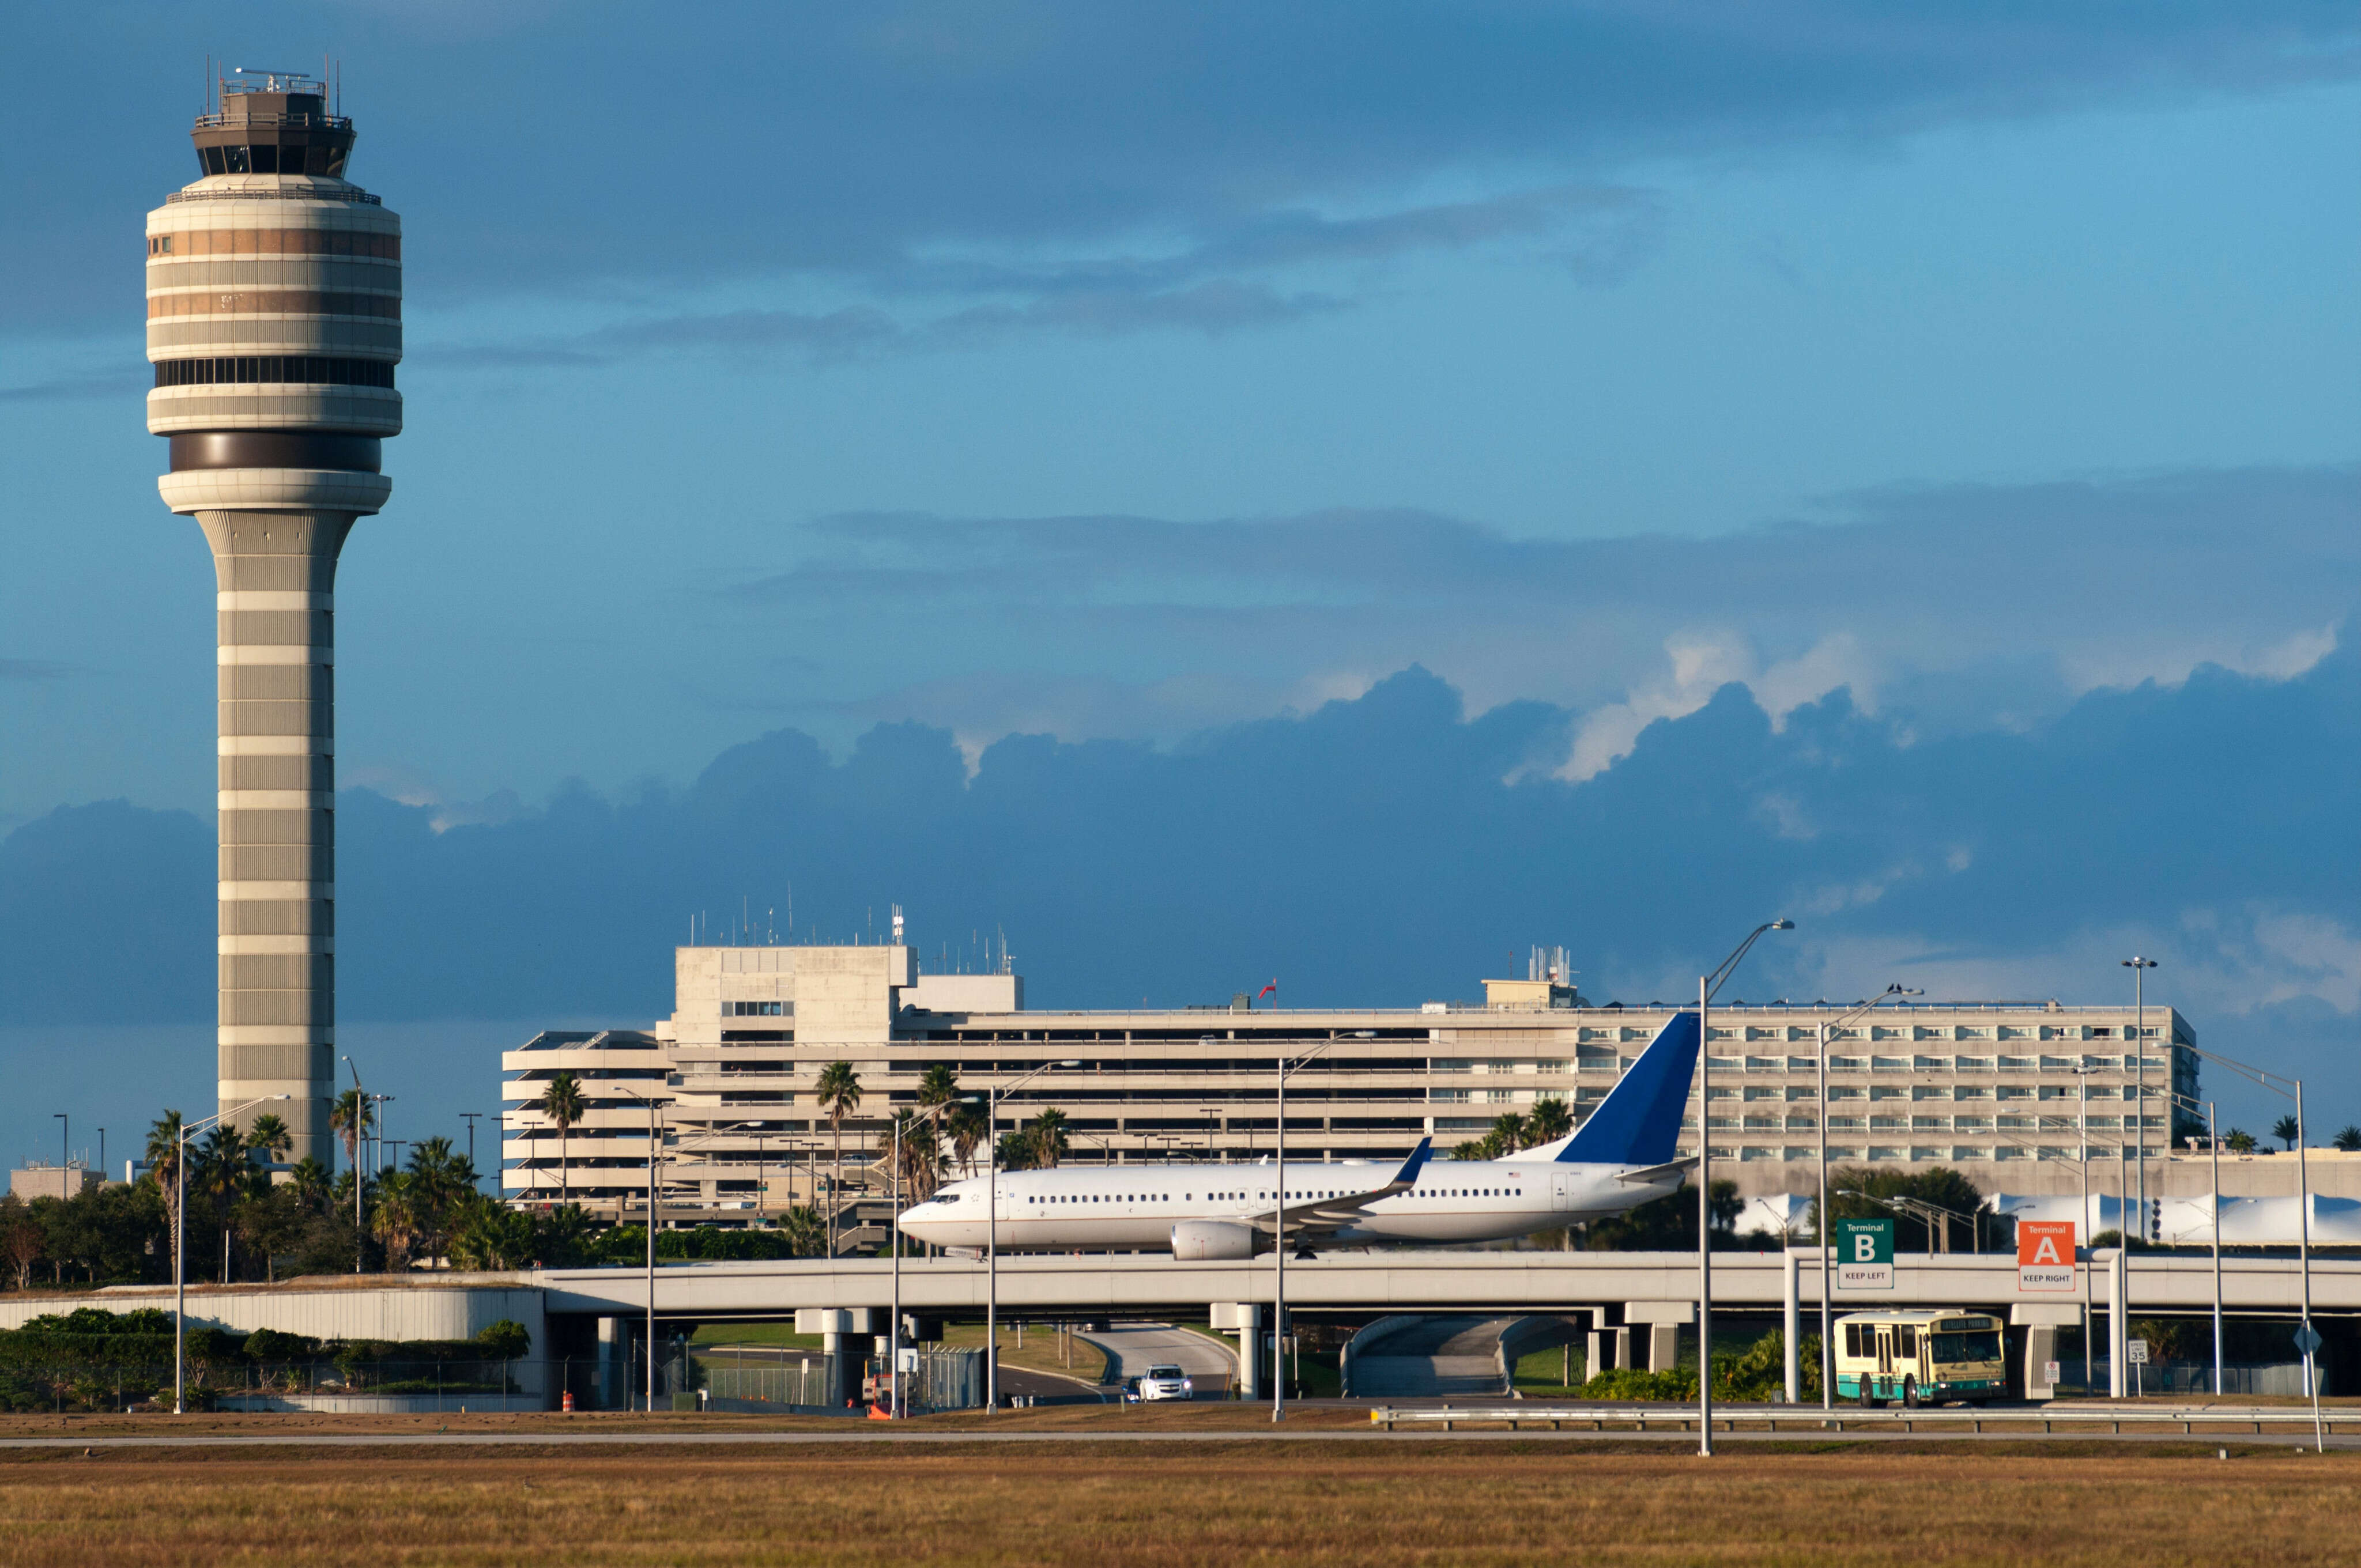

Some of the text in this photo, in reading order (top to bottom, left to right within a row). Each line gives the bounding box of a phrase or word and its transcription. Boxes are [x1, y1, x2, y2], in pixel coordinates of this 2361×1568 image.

[2028, 1226, 2066, 1234] Terminal
[1855, 1234, 1875, 1261] B
[2033, 1237, 2061, 1263] A
[2132, 1352, 2145, 1360] 35
